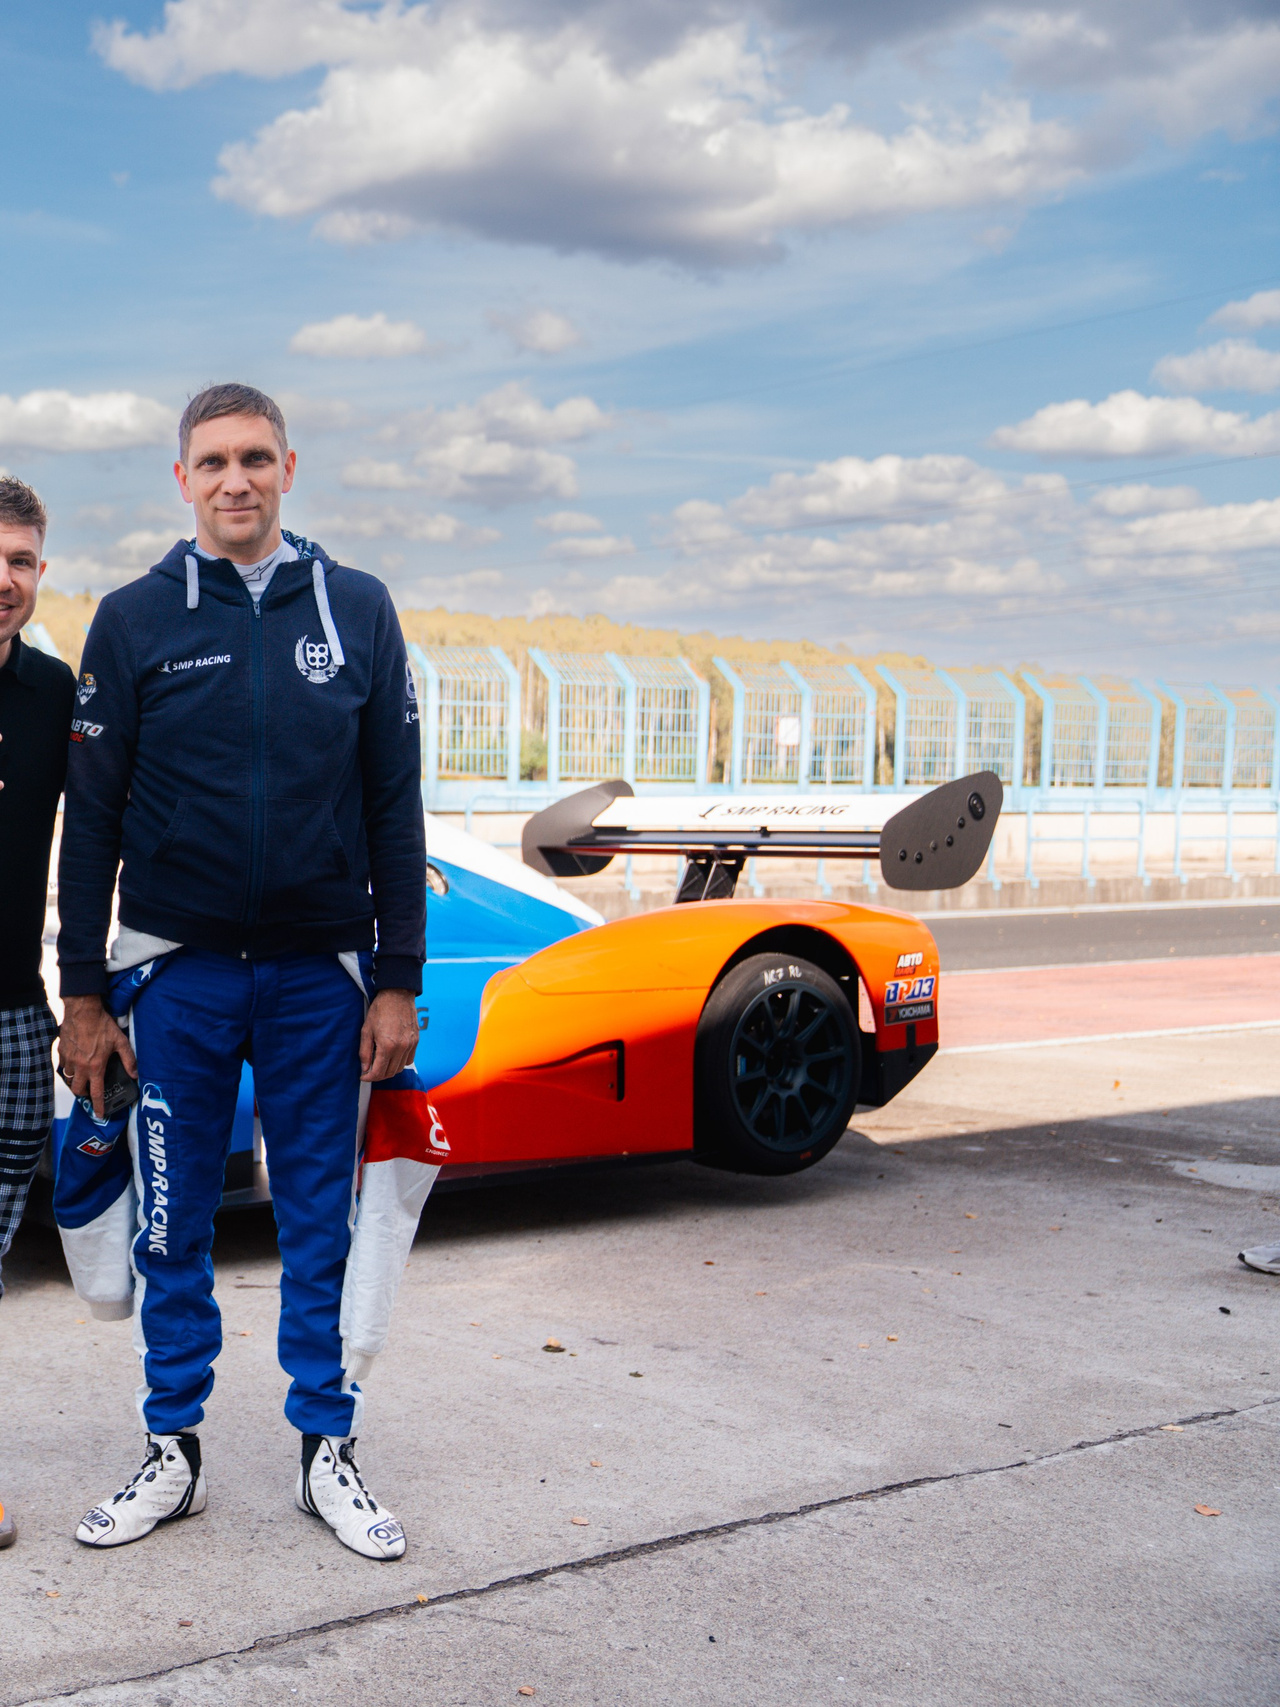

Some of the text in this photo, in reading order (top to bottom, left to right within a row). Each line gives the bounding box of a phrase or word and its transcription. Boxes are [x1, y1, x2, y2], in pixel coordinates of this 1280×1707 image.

[172, 654, 231, 671] SMP RACING
[720, 804, 850, 816] SMP RACING
[896, 952, 923, 969] АВТО
[898, 1003, 931, 1019] YOKOHAMA
[146, 1117, 169, 1256] SMP RACING
